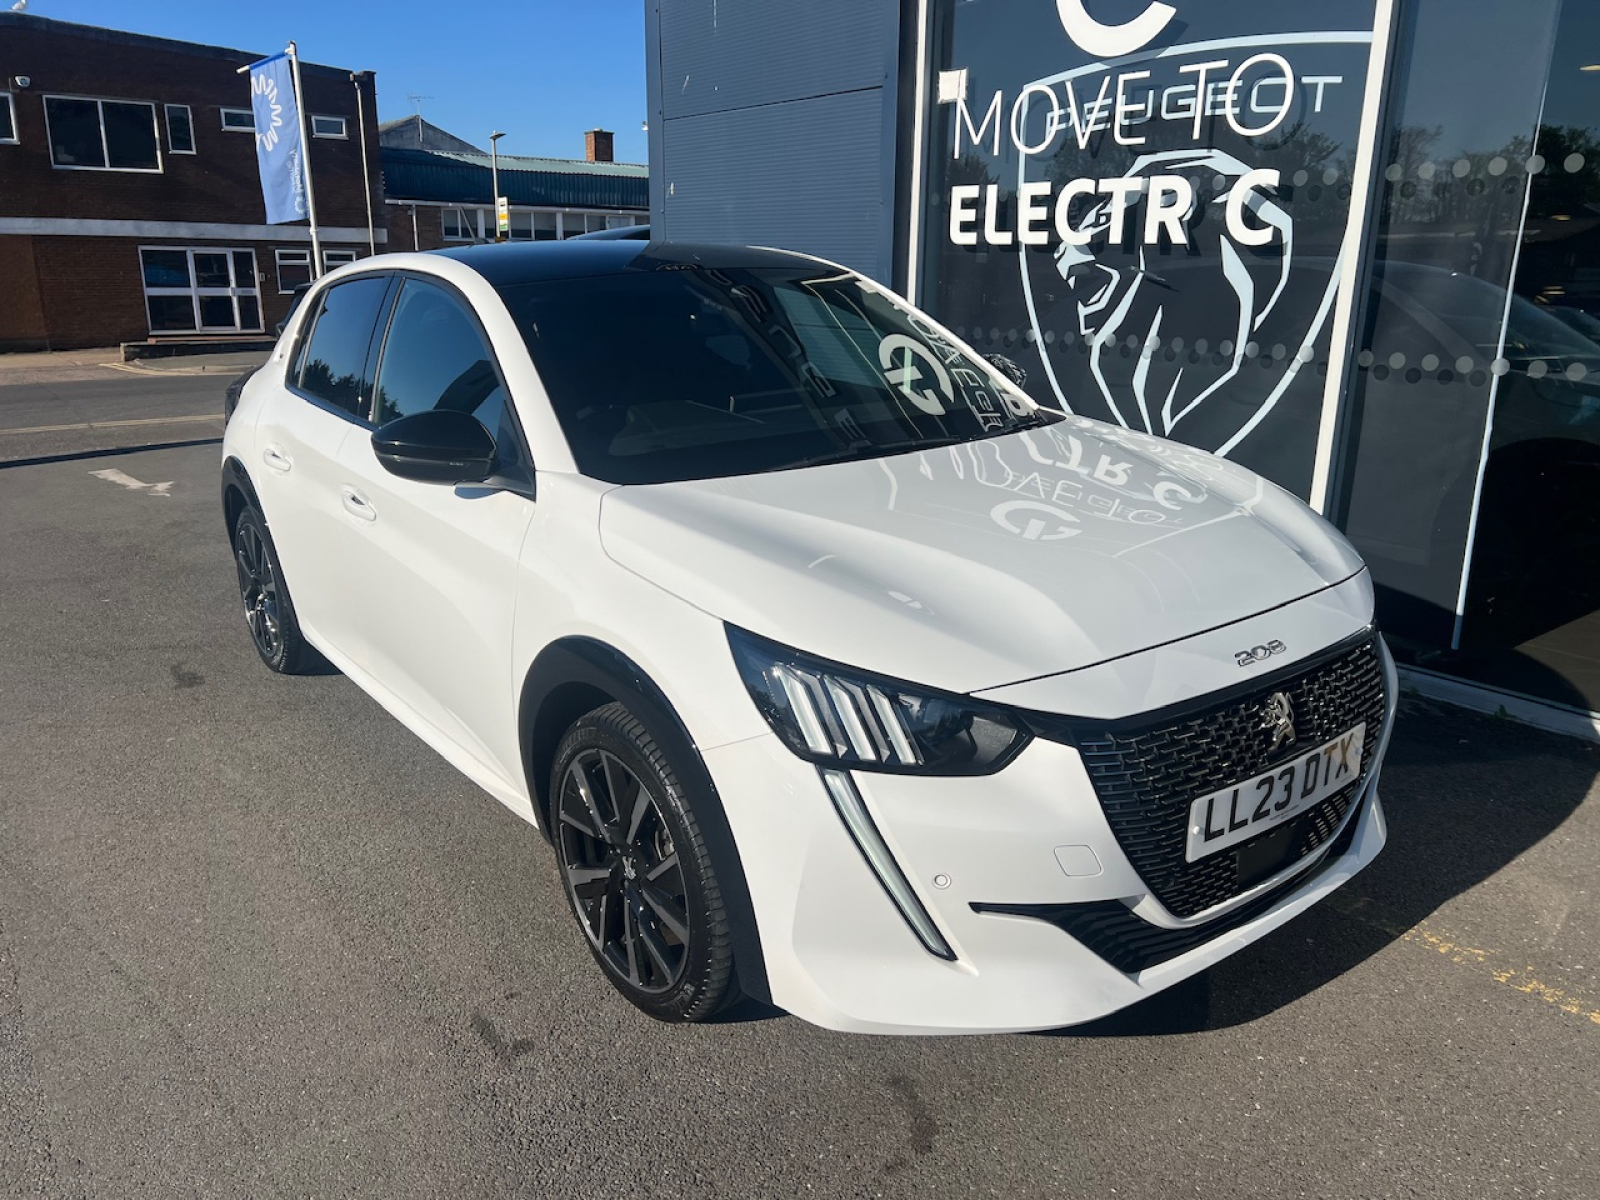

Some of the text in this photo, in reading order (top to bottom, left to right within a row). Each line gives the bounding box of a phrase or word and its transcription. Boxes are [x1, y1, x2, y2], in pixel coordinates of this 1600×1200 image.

[953, 52, 1295, 159] MOVE TO
[1044, 75, 1343, 139] PEUGEOT
[1234, 639, 1287, 667] 208
[1203, 732, 1355, 843] LL23 DTX
